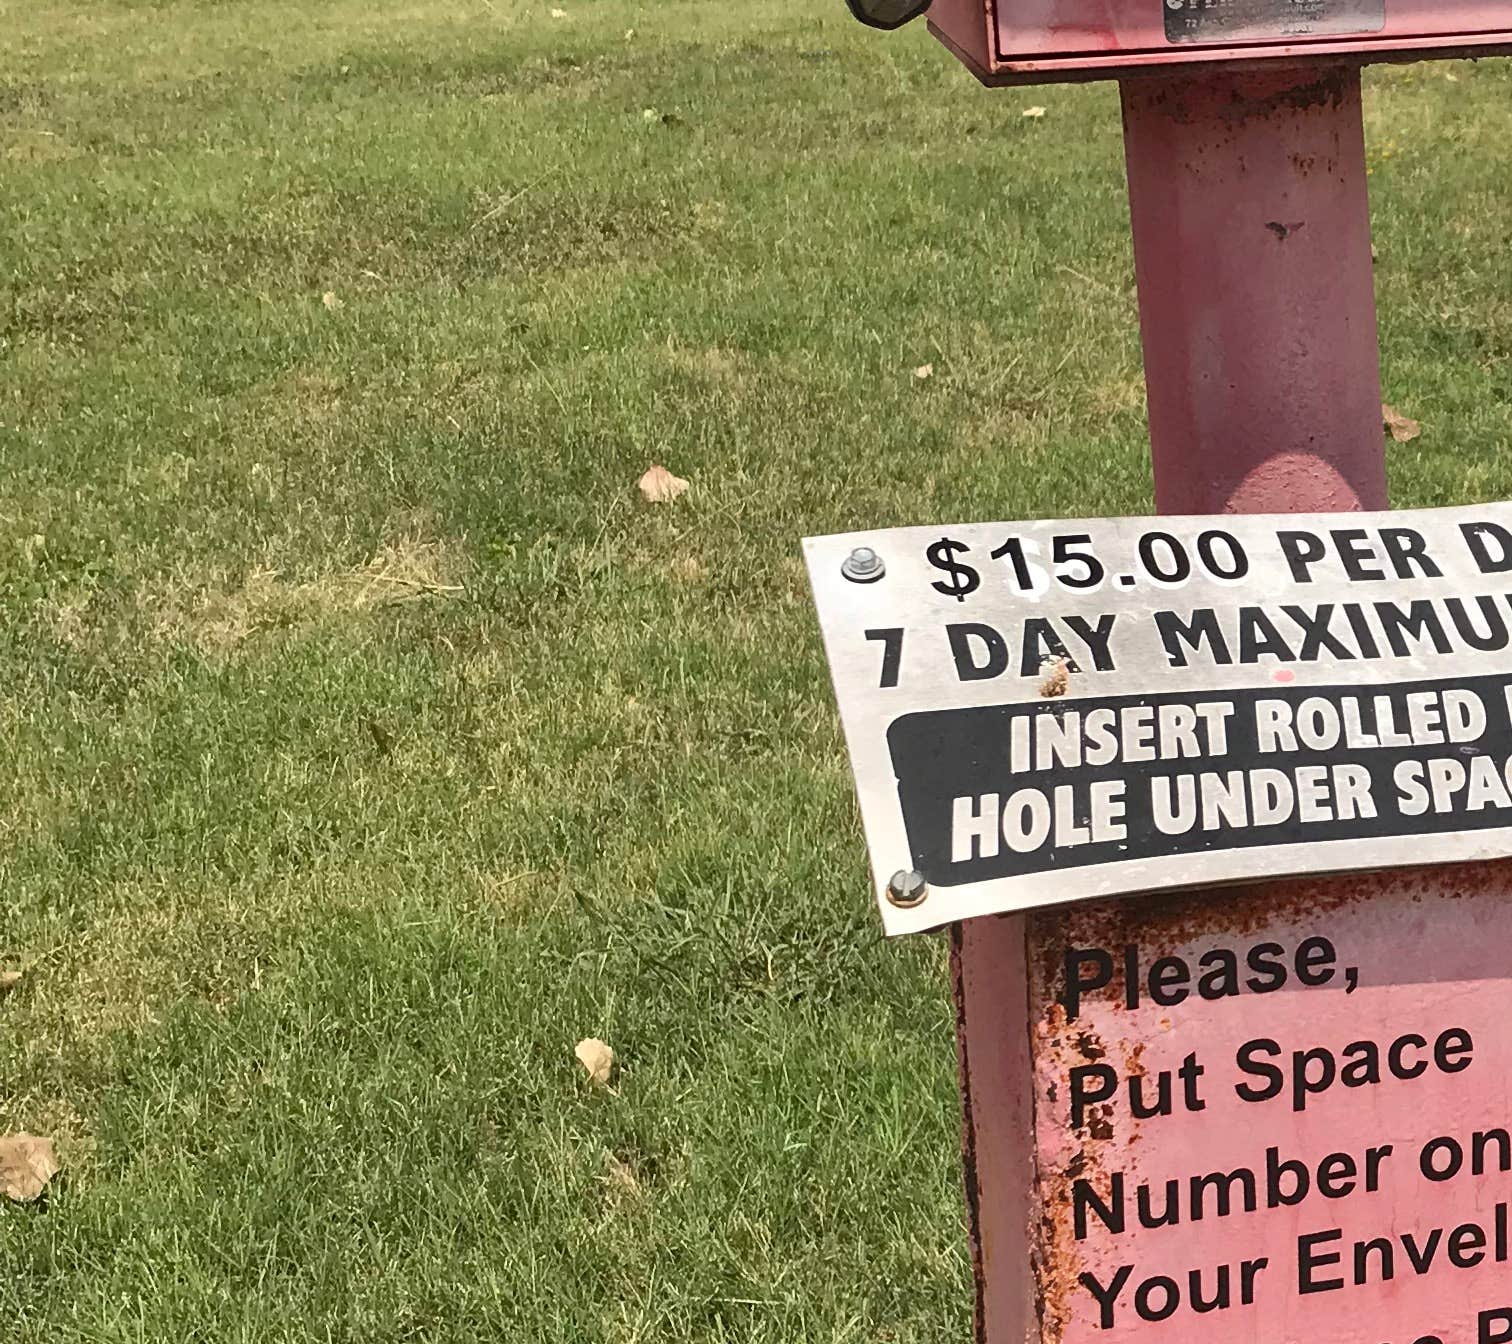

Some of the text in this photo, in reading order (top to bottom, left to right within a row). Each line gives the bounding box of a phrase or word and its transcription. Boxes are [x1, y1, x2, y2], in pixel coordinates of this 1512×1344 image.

[926, 529, 1249, 602] $15.00
[1277, 525, 1443, 585] PER
[864, 627, 905, 688] 7
[946, 613, 1115, 681] DAY
[1010, 701, 1235, 776] INSERT
[1256, 688, 1487, 754] ROLLED
[952, 780, 1128, 863] HOLE
[1150, 763, 1377, 836] UNDER
[1063, 935, 1361, 1020] Please,
[1069, 1025, 1476, 1129] Put Space
[1073, 1125, 1512, 1240] Number on
[1078, 1256, 1268, 1330] Your
